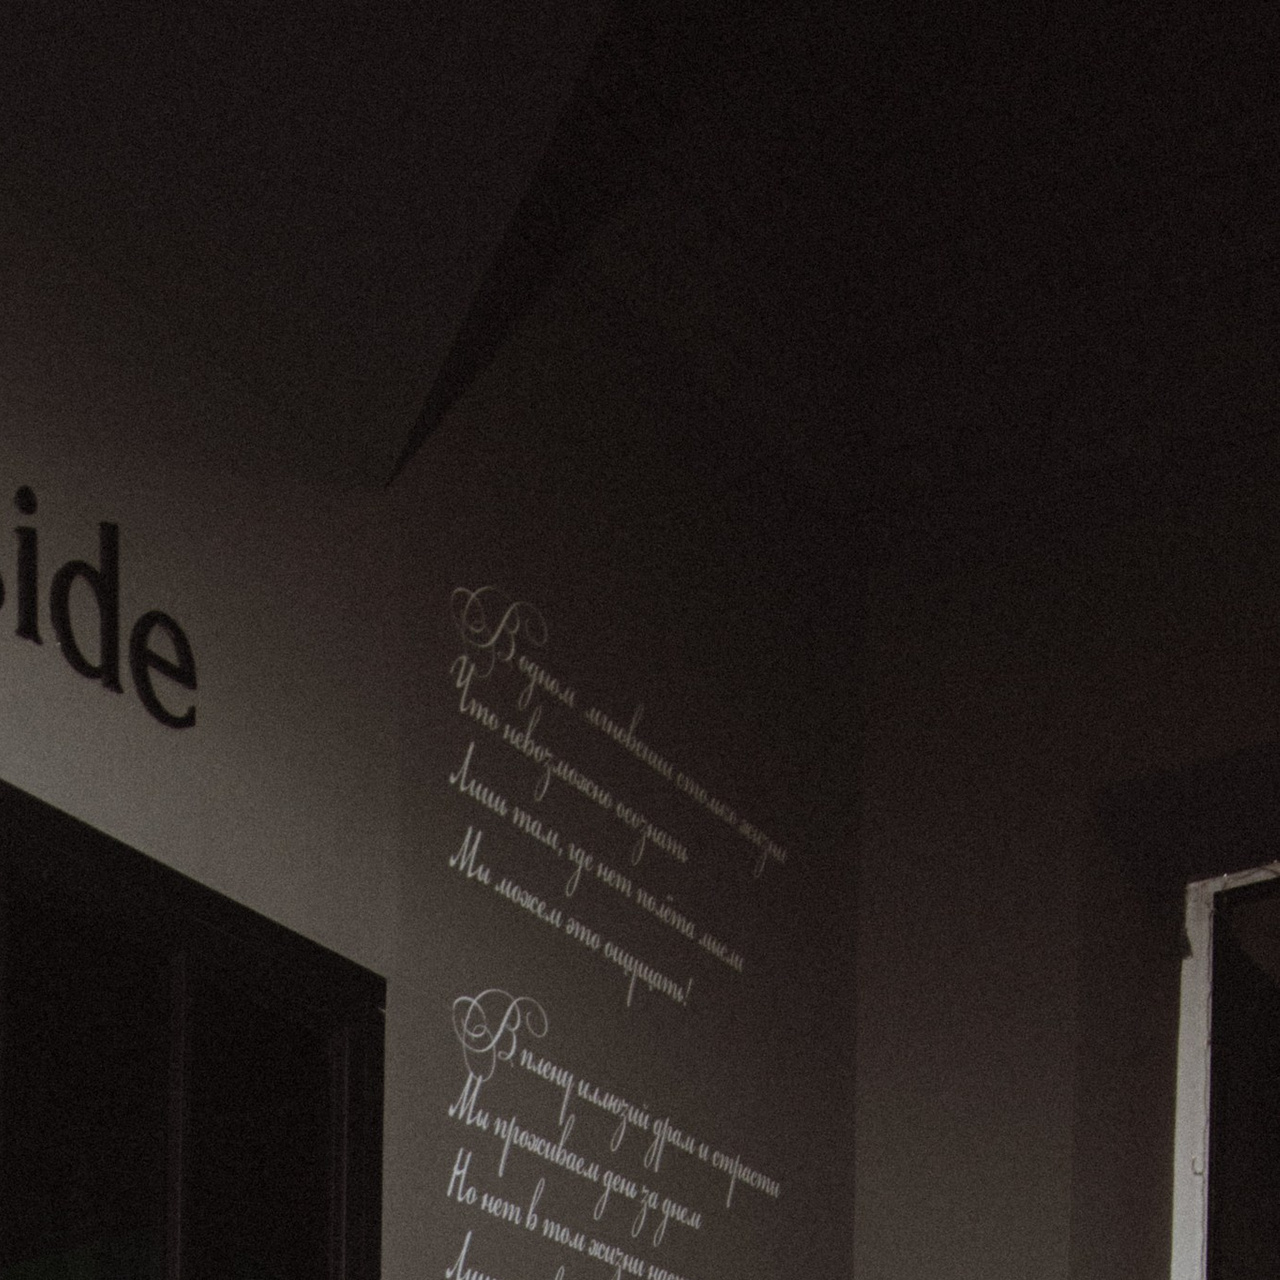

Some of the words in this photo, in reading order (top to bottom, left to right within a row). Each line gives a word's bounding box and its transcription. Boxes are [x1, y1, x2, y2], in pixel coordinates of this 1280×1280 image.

[520, 655, 576, 711] одном
[449, 741, 508, 817] Лишь
[512, 806, 564, 857] там,
[568, 839, 594, 898] где
[597, 863, 633, 898] нет
[450, 655, 499, 731] Что
[503, 705, 615, 801] невозможно
[616, 802, 689, 867] осознать
[494, 878, 562, 929] можем
[565, 917, 602, 951] это
[604, 940, 694, 1008] ощущать!
[520, 1048, 575, 1126] плену
[577, 1078, 651, 1152] иллюзий
[643, 1117, 697, 1174] драм
[698, 1140, 710, 1162] и
[447, 1147, 479, 1206] Но
[480, 1190, 524, 1226] нет
[526, 1177, 546, 1232] в
[543, 1216, 586, 1253] том
[494, 1113, 601, 1178] проживаем
[594, 1168, 638, 1221] день
[631, 1185, 659, 1239] за
